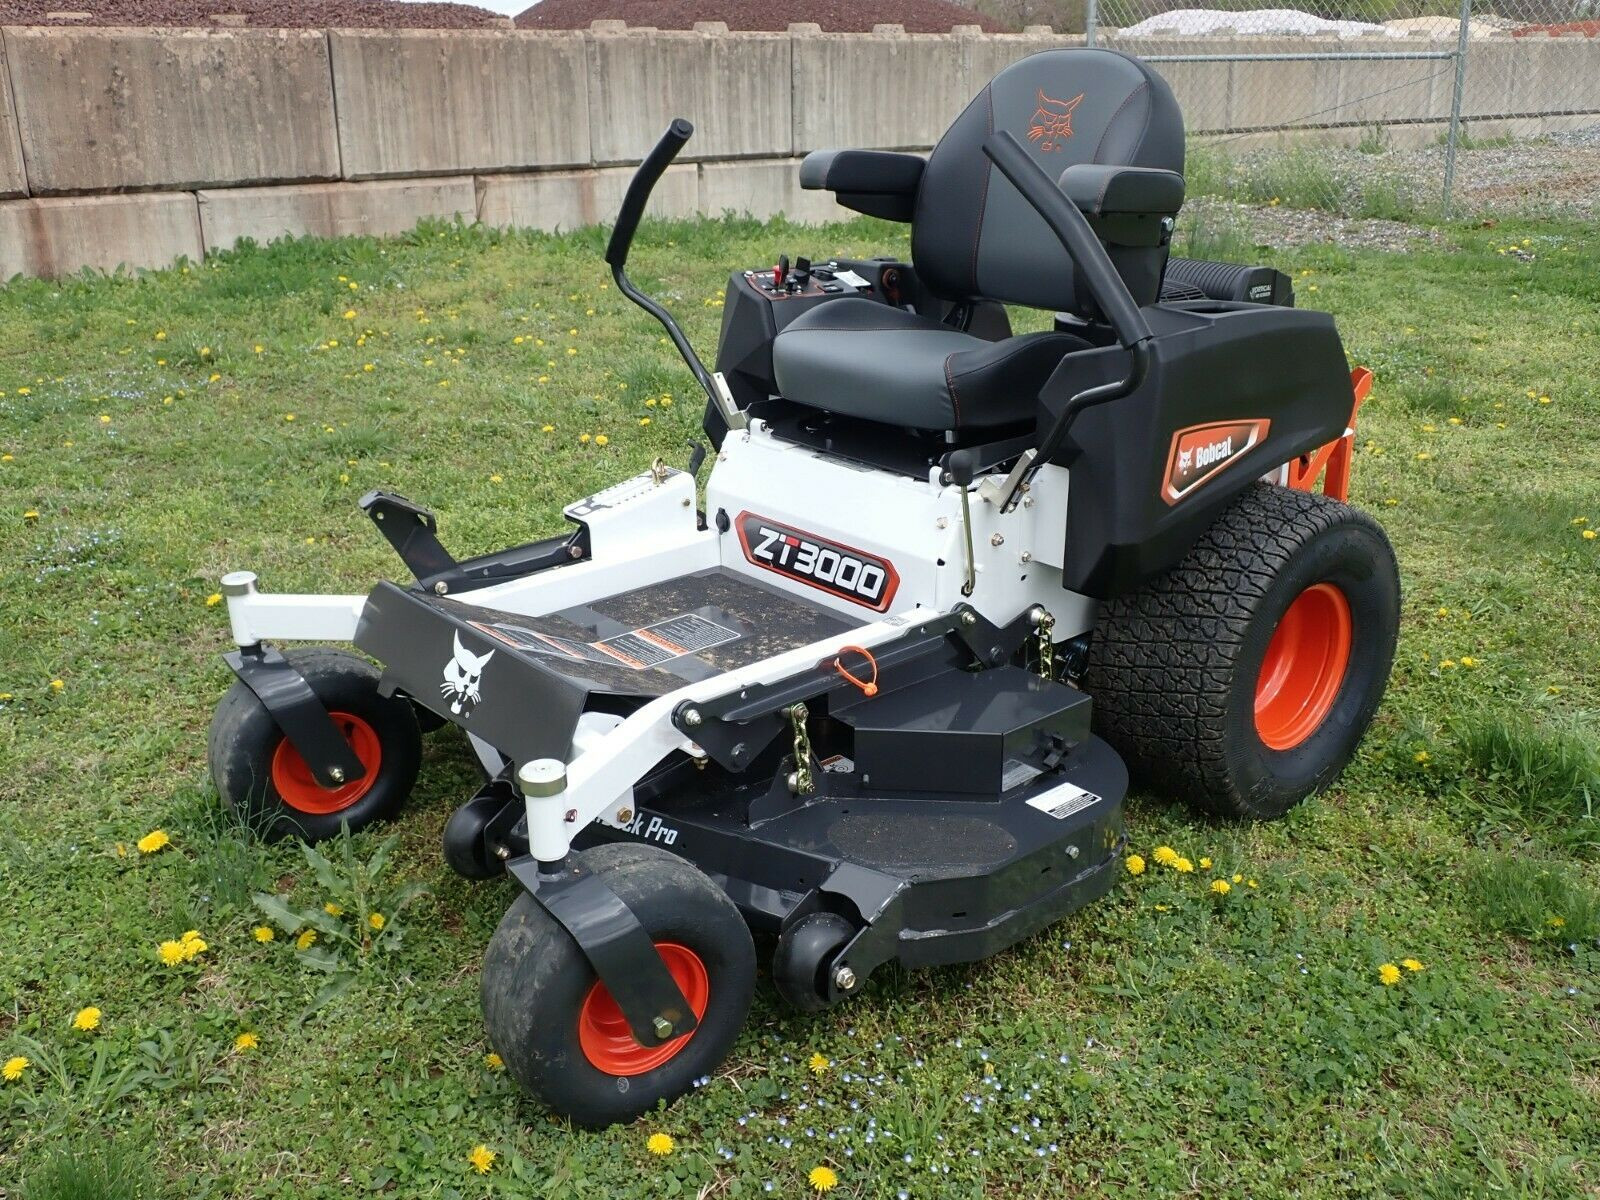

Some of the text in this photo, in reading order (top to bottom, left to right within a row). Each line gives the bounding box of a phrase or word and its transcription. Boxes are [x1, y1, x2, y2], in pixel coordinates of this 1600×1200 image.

[1195, 435, 1232, 468] Bobcat
[753, 527, 886, 600] ZT3000
[644, 816, 678, 845] Pro
